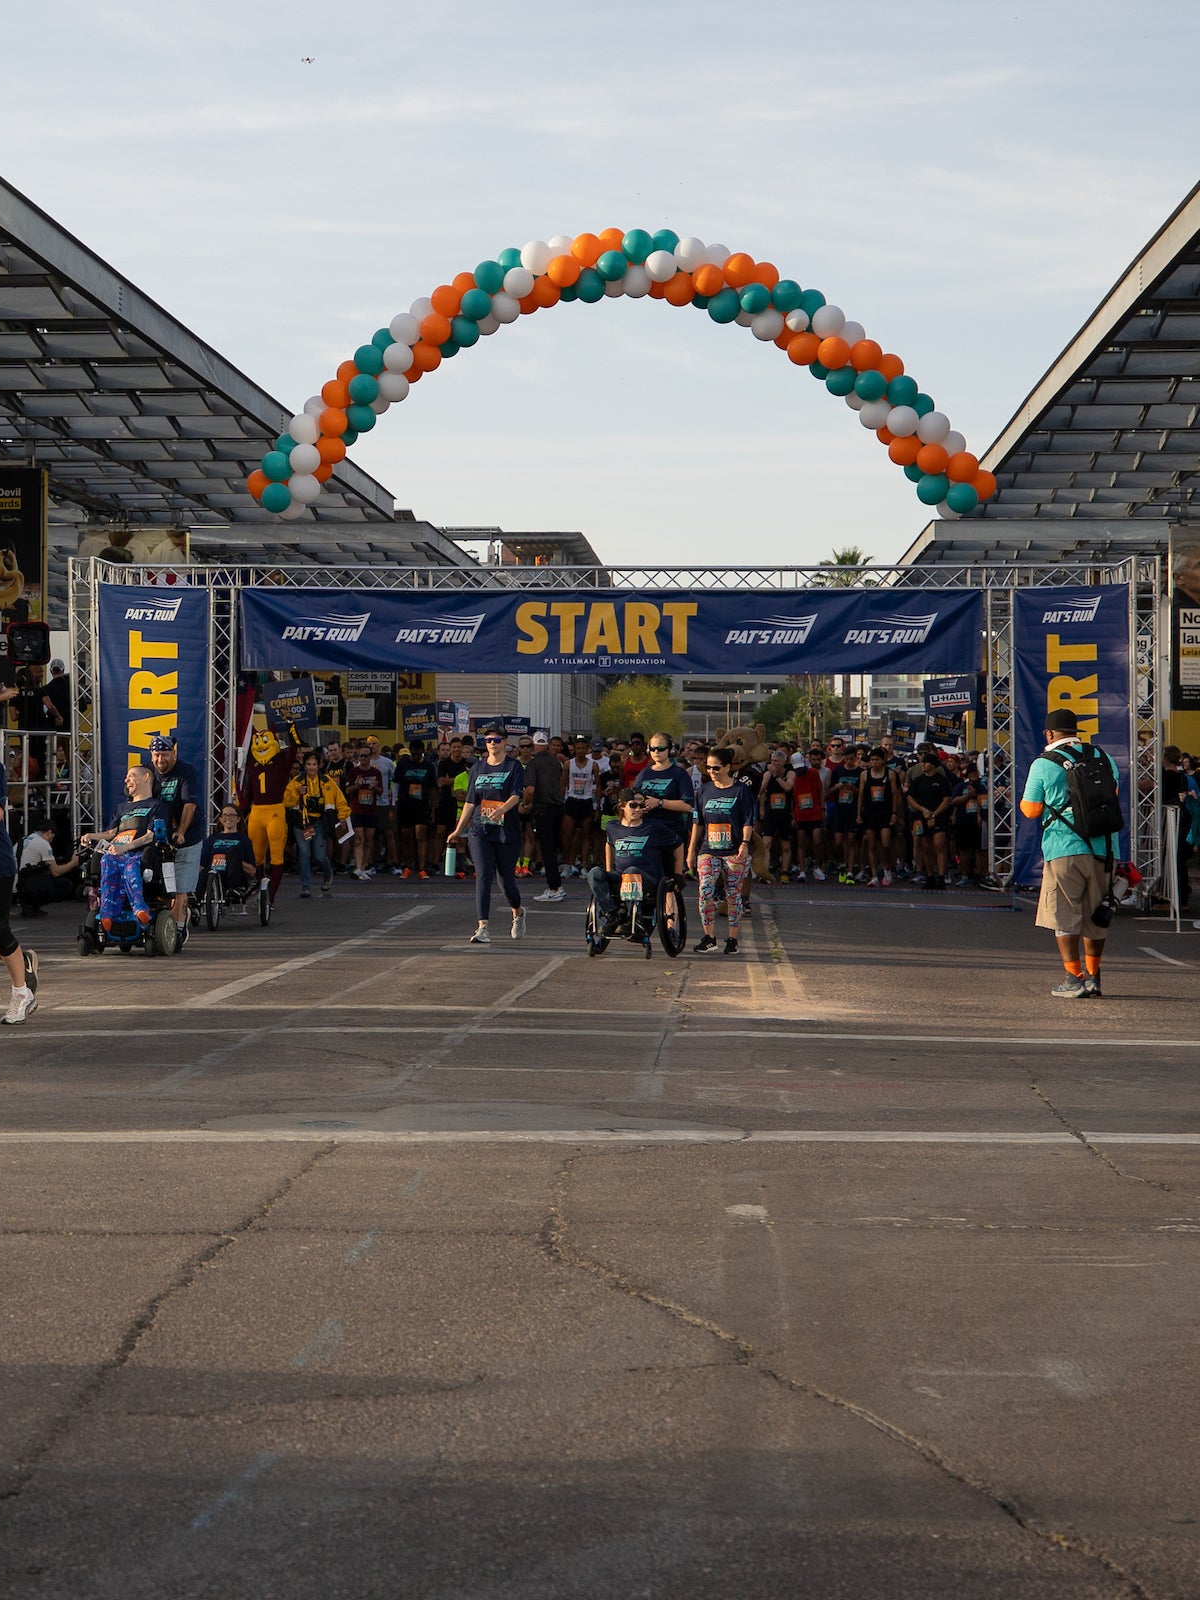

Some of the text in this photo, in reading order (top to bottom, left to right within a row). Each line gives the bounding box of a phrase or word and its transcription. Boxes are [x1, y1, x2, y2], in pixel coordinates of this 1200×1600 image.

[125, 604, 180, 621] PAT'S RUN
[1042, 605, 1097, 623] PAT'S RUN
[281, 621, 364, 642] PAT'S RUN
[394, 623, 478, 644] PAT'S RUN
[515, 602, 698, 654] START
[725, 623, 810, 645] PAT'S RUN
[844, 623, 930, 644] PAT'S RUN
[350, 684, 373, 692] raight
[270, 696, 310, 709] CORRAL 1
[932, 693, 968, 702] U-HAUL
[405, 716, 429, 724] CORRAL
[258, 772, 266, 794] 1
[708, 832, 731, 842] 26078
